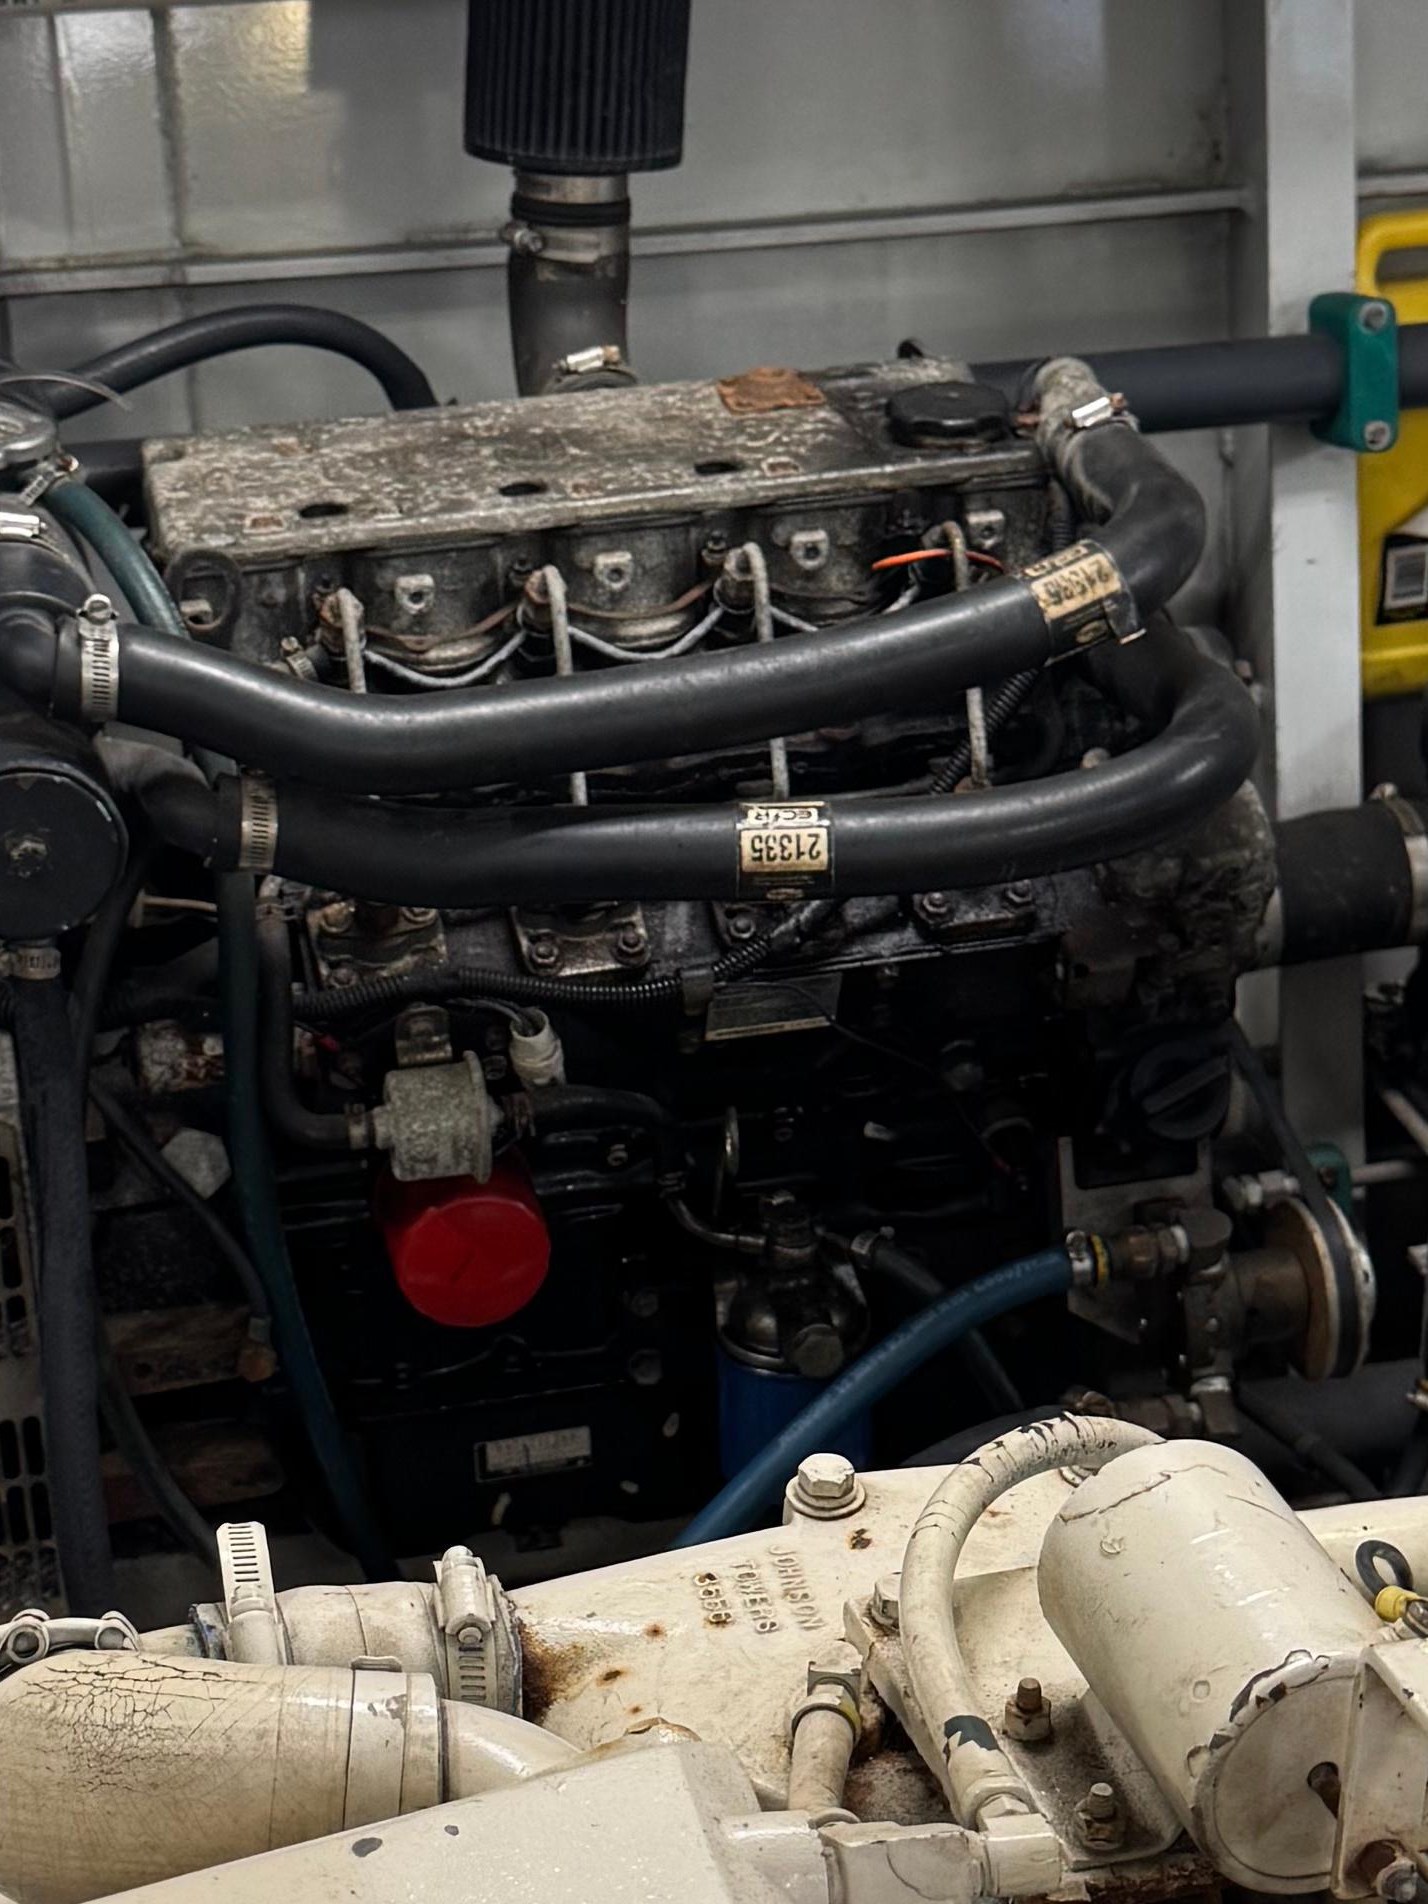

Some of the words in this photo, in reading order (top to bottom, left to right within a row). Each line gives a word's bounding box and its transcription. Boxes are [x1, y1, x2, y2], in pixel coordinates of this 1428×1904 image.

[750, 833, 821, 862] 21335
[730, 1560, 780, 1635] TOWERS
[769, 1545, 827, 1631] JOHNSON
